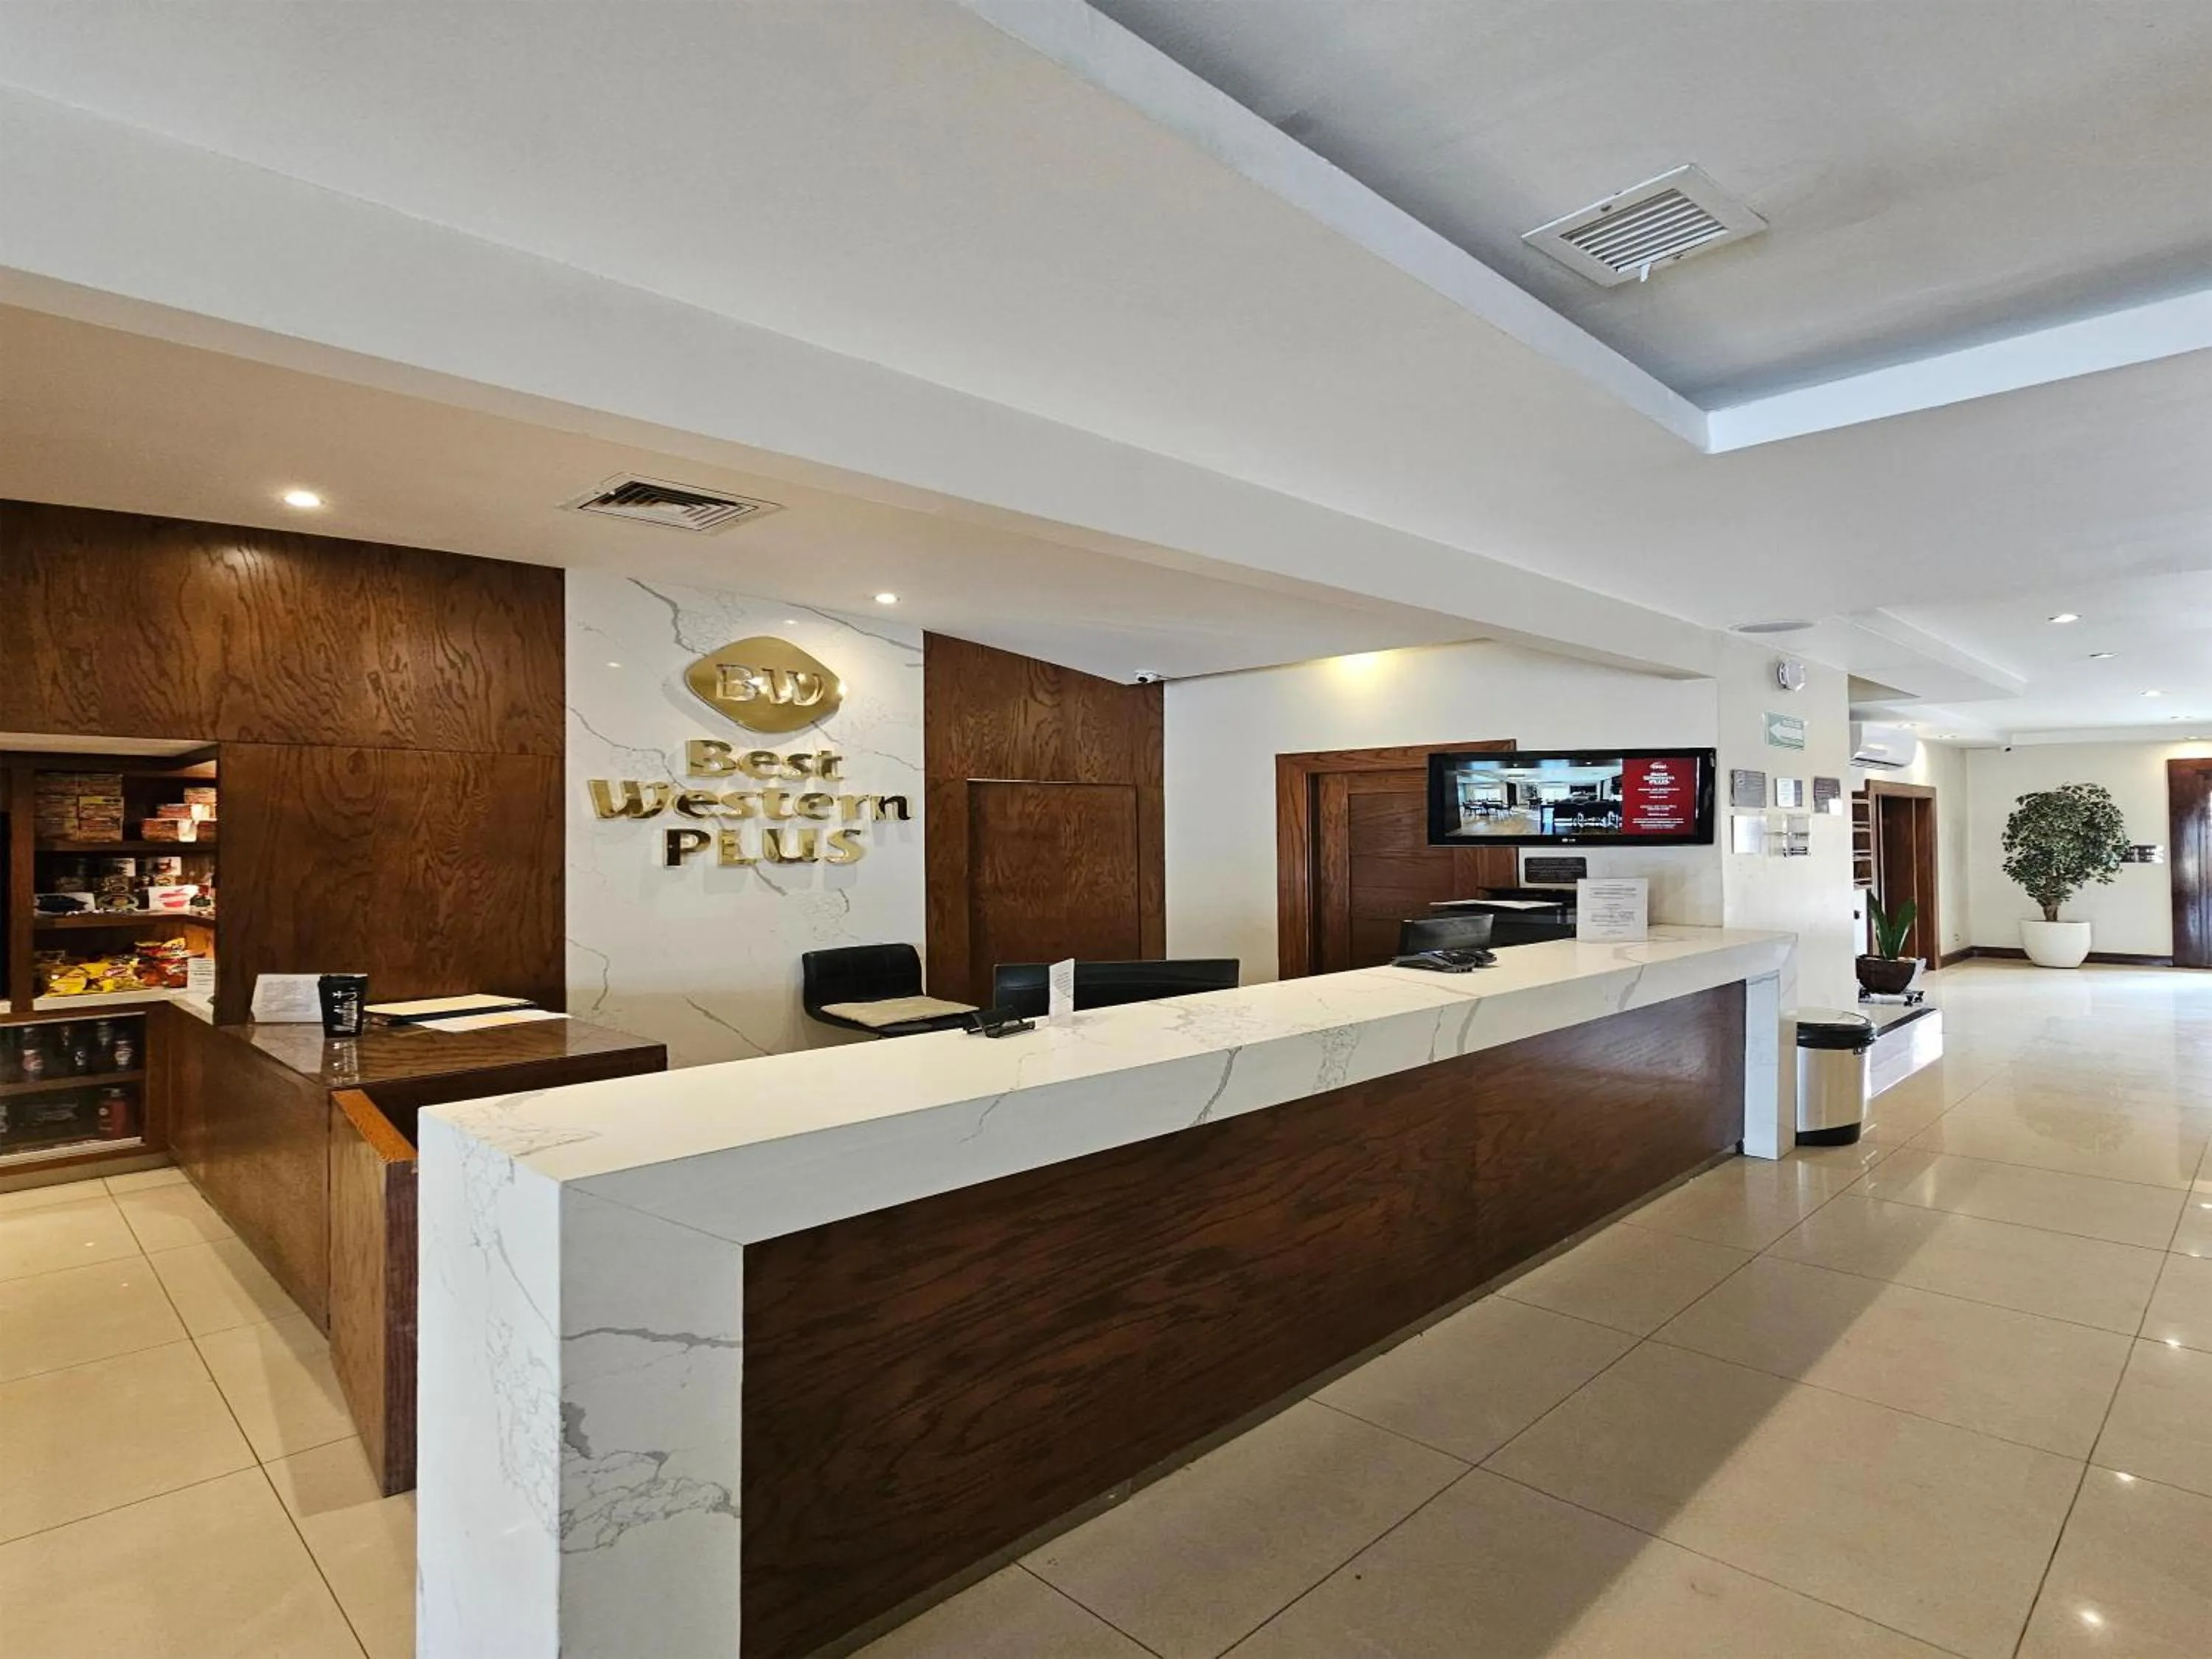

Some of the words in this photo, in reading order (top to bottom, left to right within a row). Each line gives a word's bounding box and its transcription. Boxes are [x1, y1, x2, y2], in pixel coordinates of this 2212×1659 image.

[716, 664, 824, 706] BW
[686, 740, 844, 782] Best
[587, 779, 913, 821] Western
[666, 828, 868, 866] PLUS
